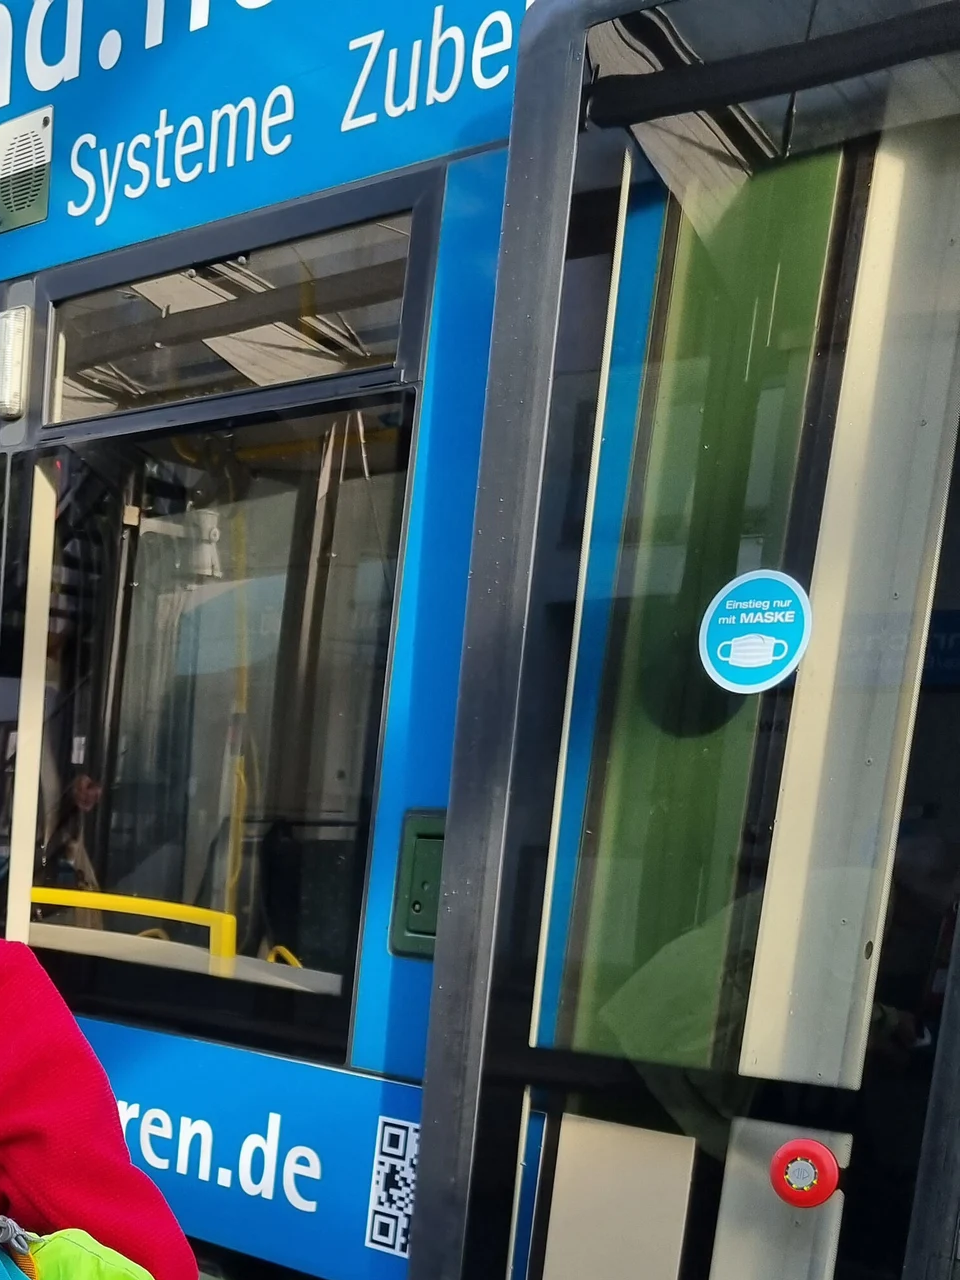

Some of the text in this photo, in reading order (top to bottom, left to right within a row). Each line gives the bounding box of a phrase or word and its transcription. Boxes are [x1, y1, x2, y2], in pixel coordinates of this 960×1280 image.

[66, 84, 296, 227] Systeme
[340, 1, 536, 133] Zube
[718, 611, 795, 625] mit MASKE
[726, 599, 792, 610] Einstieg nur
[116, 1099, 323, 1214] ren.de
